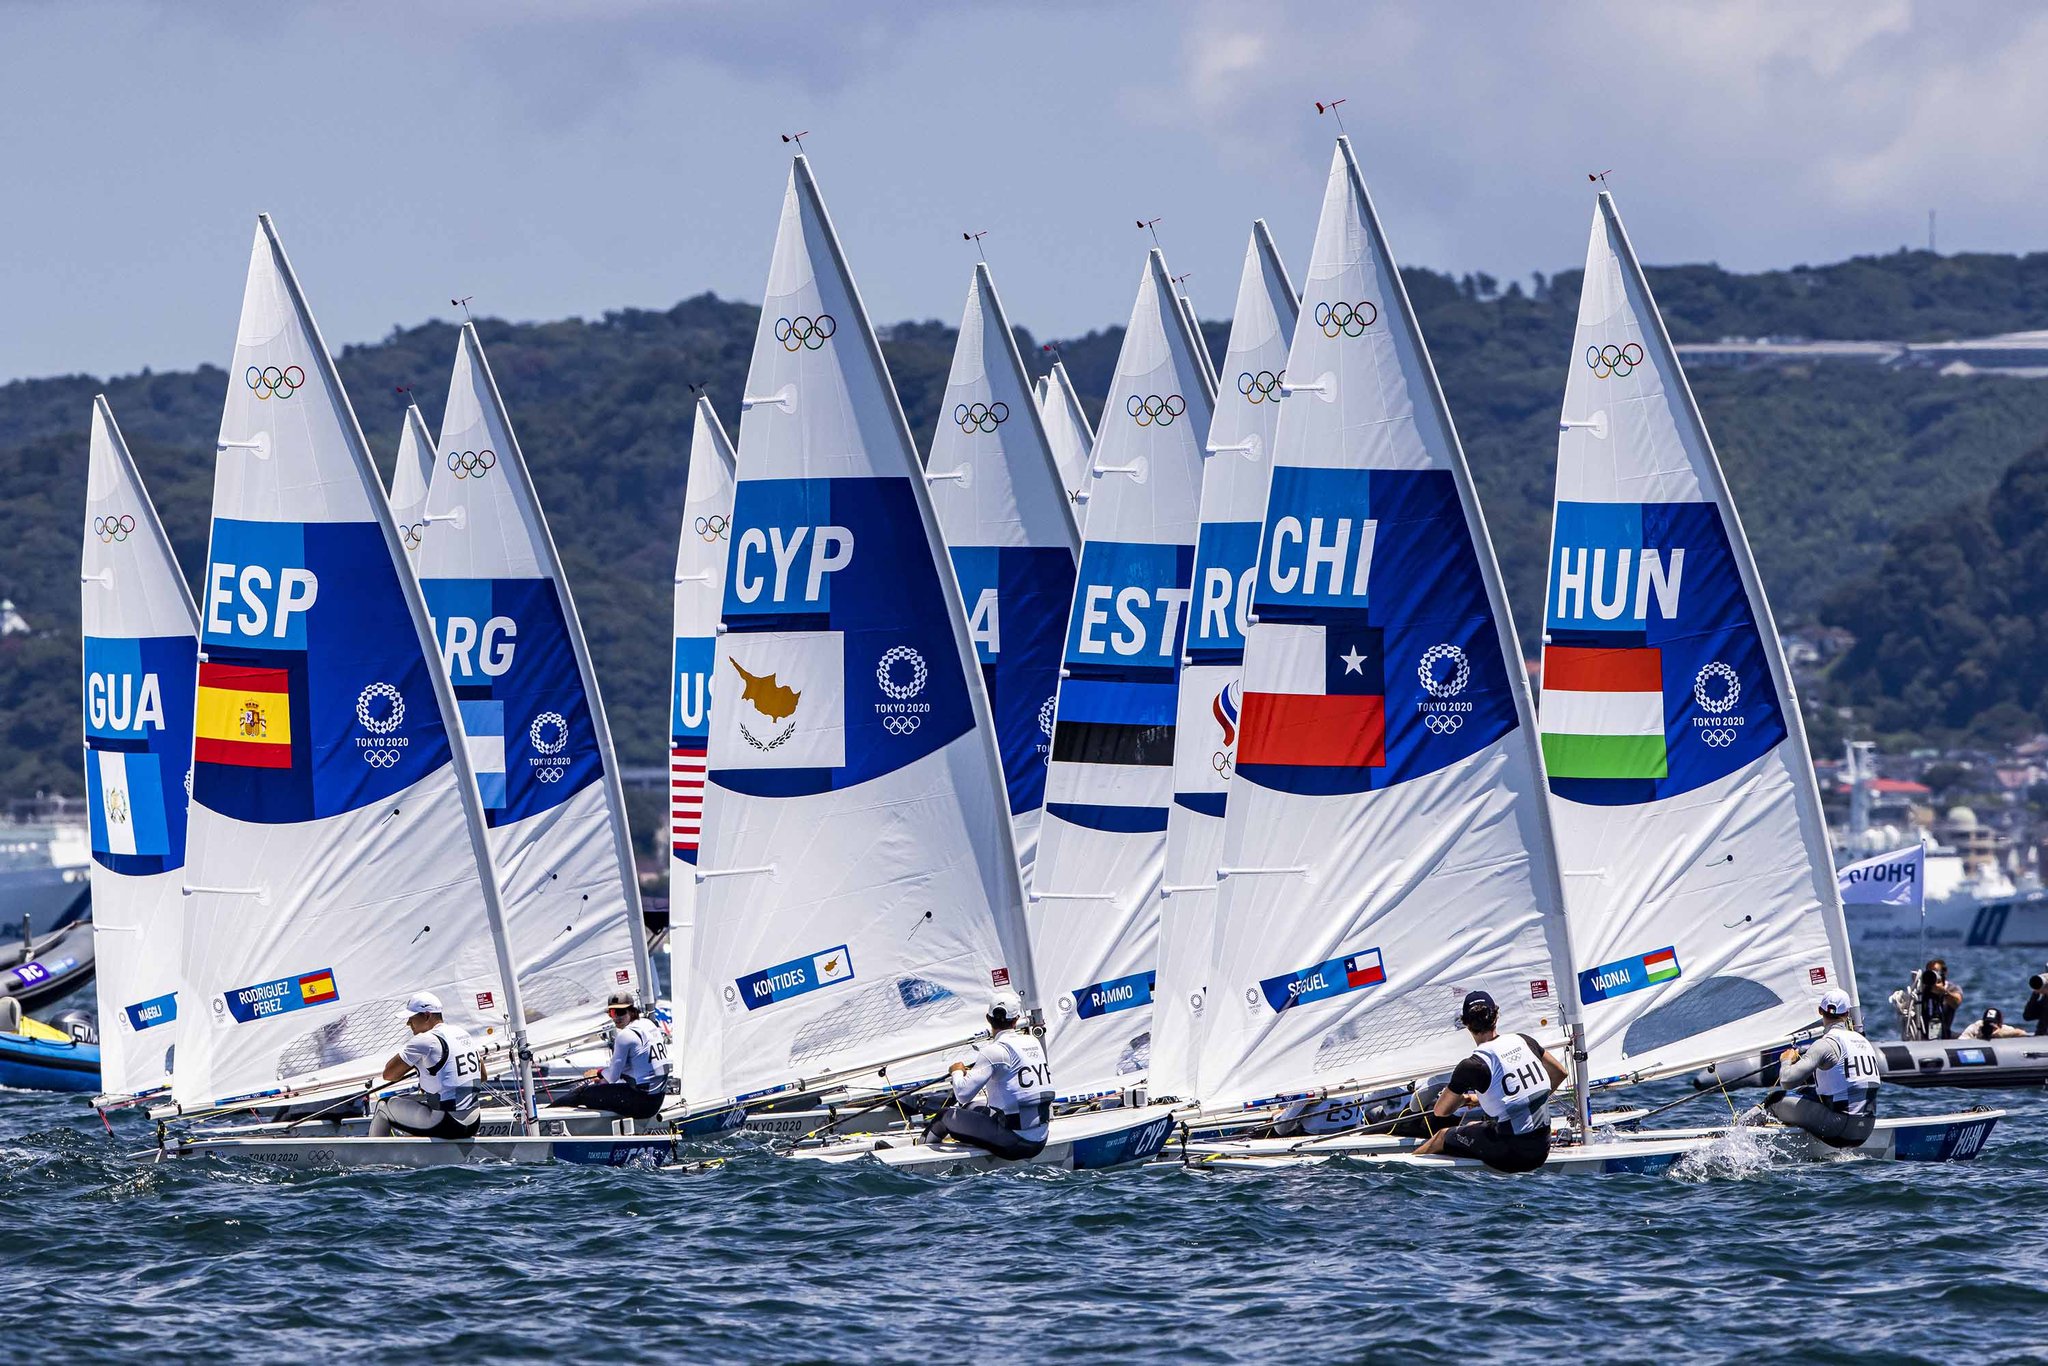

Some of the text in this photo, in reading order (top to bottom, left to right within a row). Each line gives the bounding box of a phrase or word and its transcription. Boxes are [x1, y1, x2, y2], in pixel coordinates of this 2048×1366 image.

[735, 525, 855, 605] CYP
[1269, 516, 1378, 597] CHI
[1557, 547, 1686, 621] HUN
[206, 561, 319, 639] ESP
[1079, 584, 1192, 656] EST
[88, 672, 166, 732] GUA
[680, 672, 714, 729] U
[874, 703, 931, 714] TOKYO 2020
[1416, 701, 1473, 712] TOKYO 2020
[1692, 716, 1745, 727] TOKYO 2020
[355, 737, 409, 748] TOKYO 2020
[528, 756, 571, 766] TOKYO 2020
[18, 964, 44, 982] RC
[752, 968, 806, 998] KONTIDES
[1590, 968, 1631, 991] VADNAI
[238, 981, 290, 1005] RODRIGUEZ
[1091, 984, 1133, 1007] RAMMO
[1287, 972, 1329, 998] SEGUEL
[138, 1004, 163, 1022] MAEGLI
[253, 997, 283, 1017] PEREZ
[648, 1041, 668, 1064] AR
[1501, 1060, 1544, 1097] CHI
[775, 1120, 802, 1132] 2020
[1134, 1119, 1168, 1156] CYP
[1951, 1123, 1986, 1157] HUN
[277, 1153, 299, 1162] 2020
